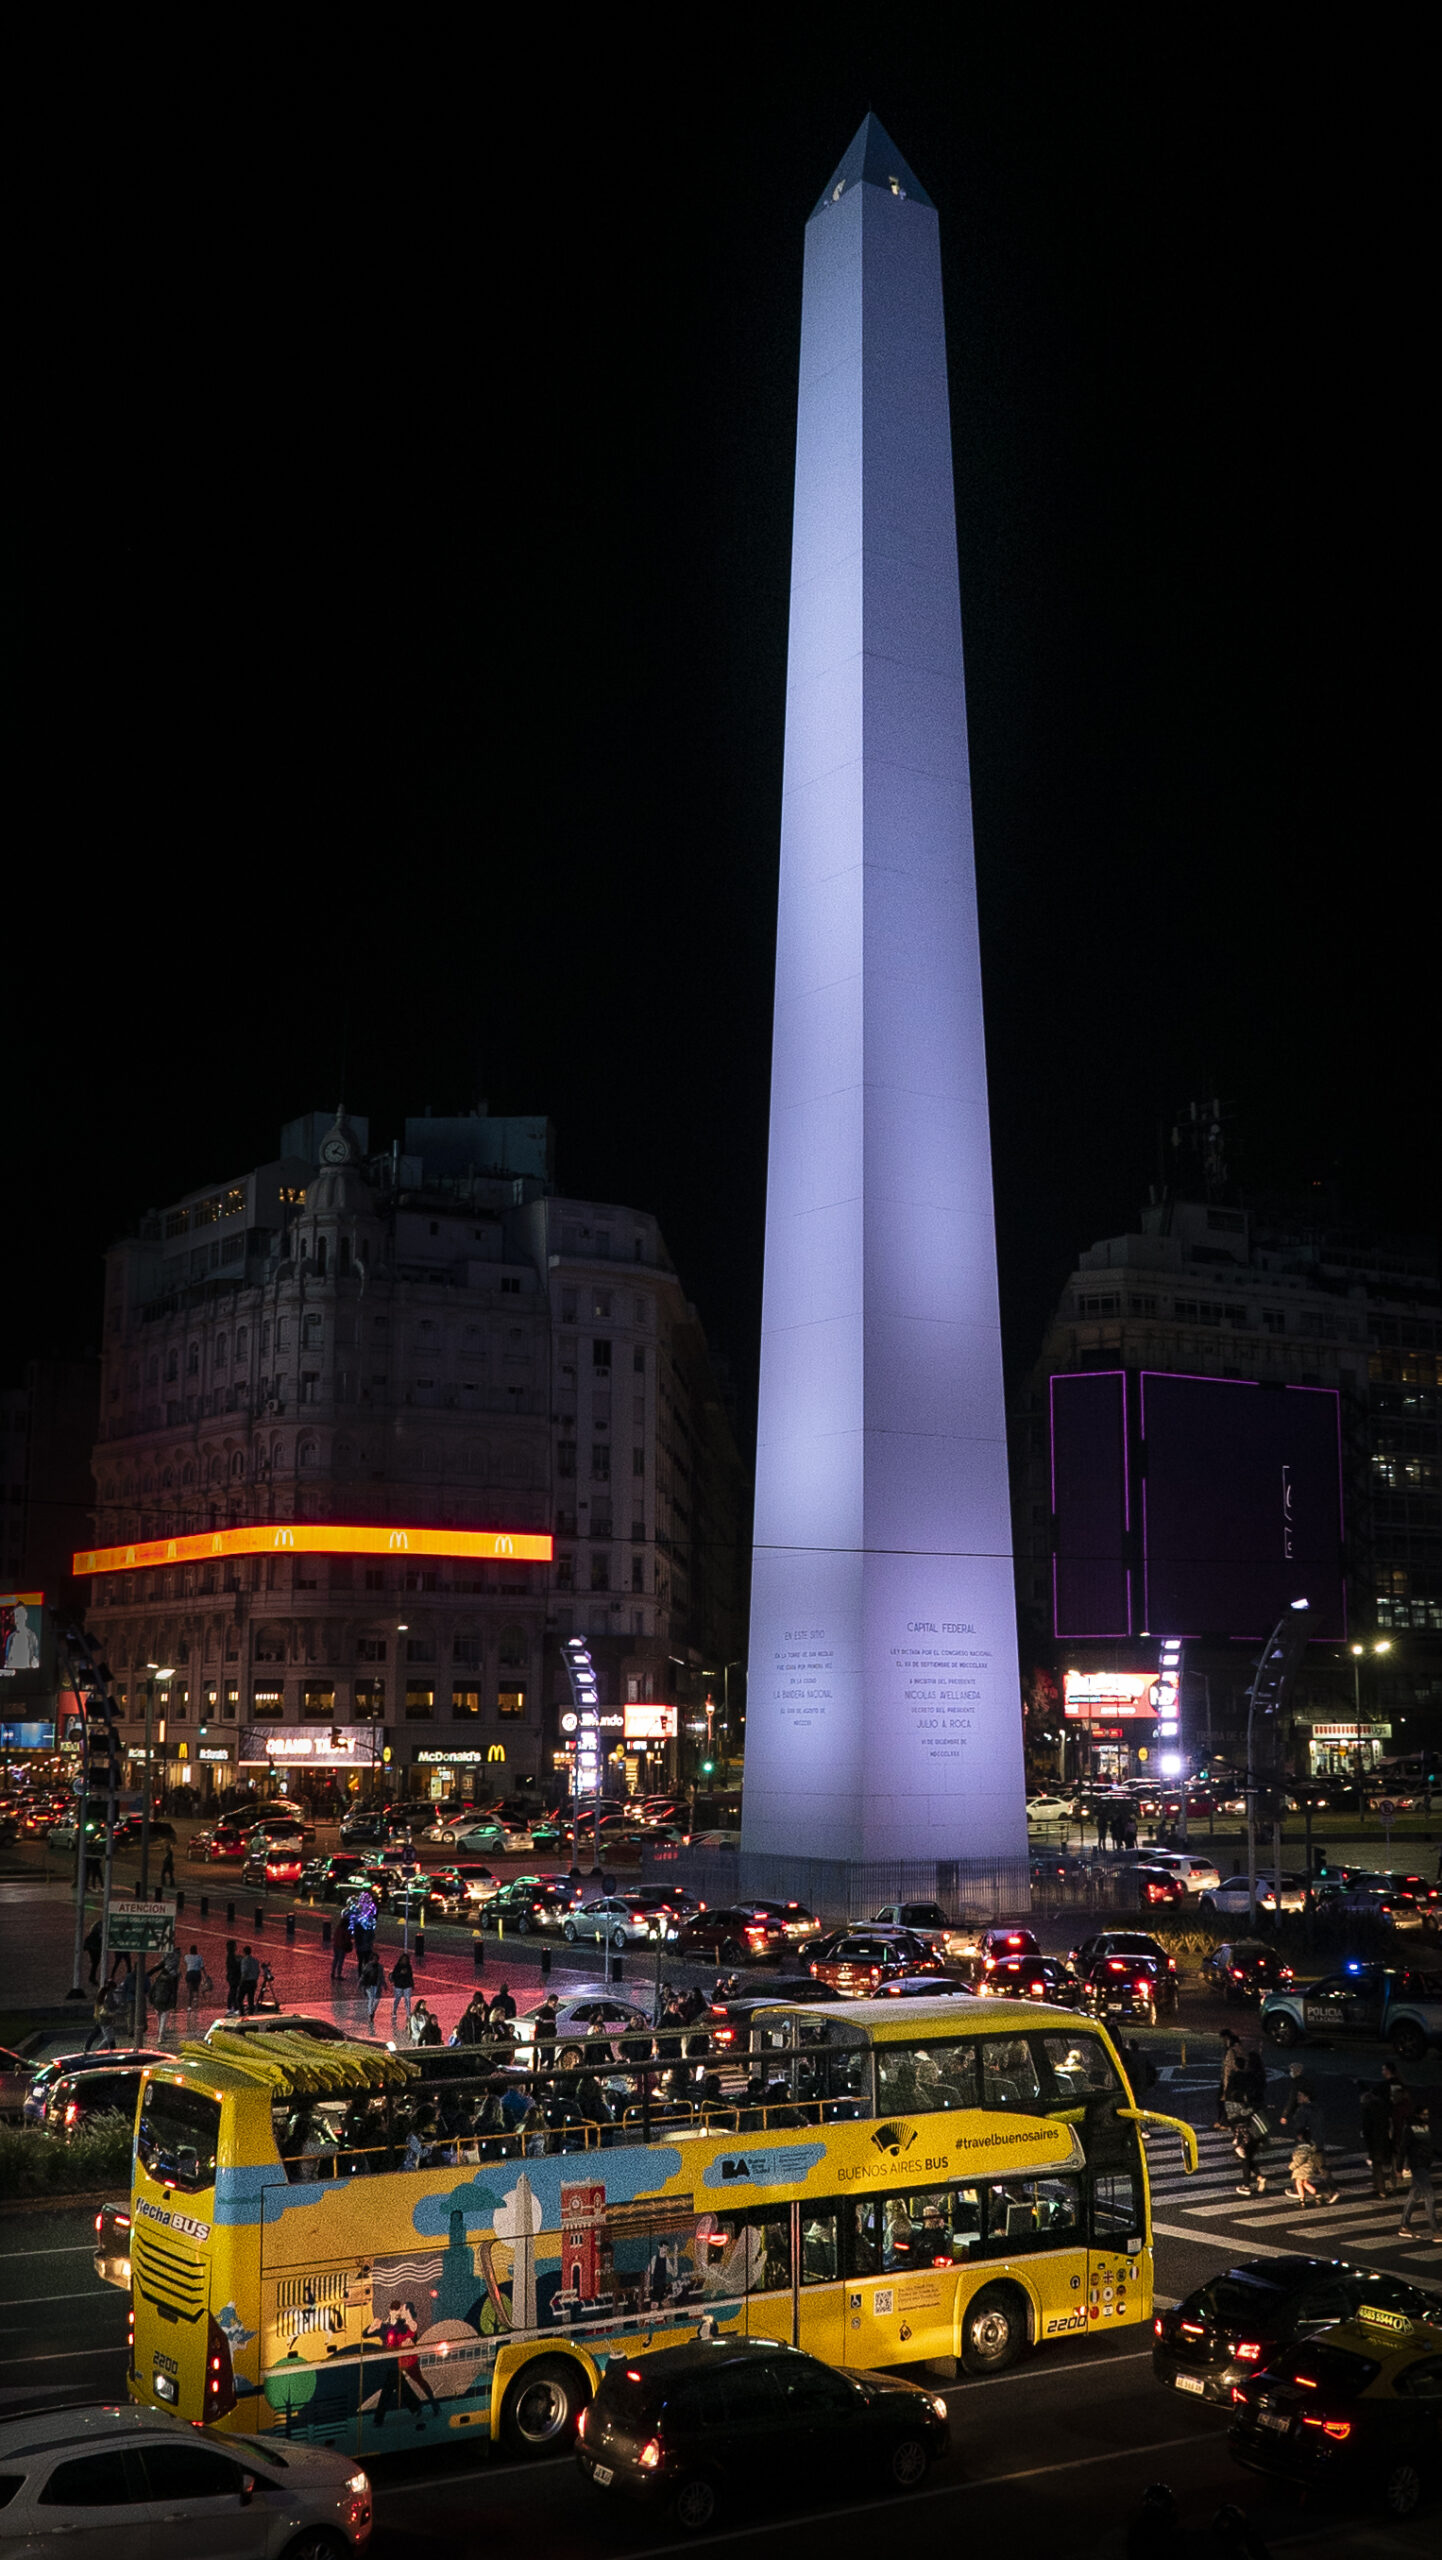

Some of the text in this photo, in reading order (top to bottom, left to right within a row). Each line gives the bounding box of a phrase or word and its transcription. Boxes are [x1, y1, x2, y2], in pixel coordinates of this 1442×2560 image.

[907, 1622, 976, 1634] CAPITAL FEDERAL
[904, 1690, 981, 1700] NICOLAS AVELLANEDA
[916, 1719, 938, 1728] JULIO
[950, 1719, 971, 1728] ROCA
[418, 1751, 481, 1762] McDonald's
[119, 1904, 166, 1913] ATENCION
[1307, 2007, 1343, 2016] POLICIA
[955, 2128, 1059, 2150] #travelbuenosaires
[722, 2159, 750, 2179] BA
[838, 2157, 949, 2181] BUENOS AIRES BUS
[1047, 2315, 1087, 2333] 2200
[153, 2350, 178, 2375] 2200
